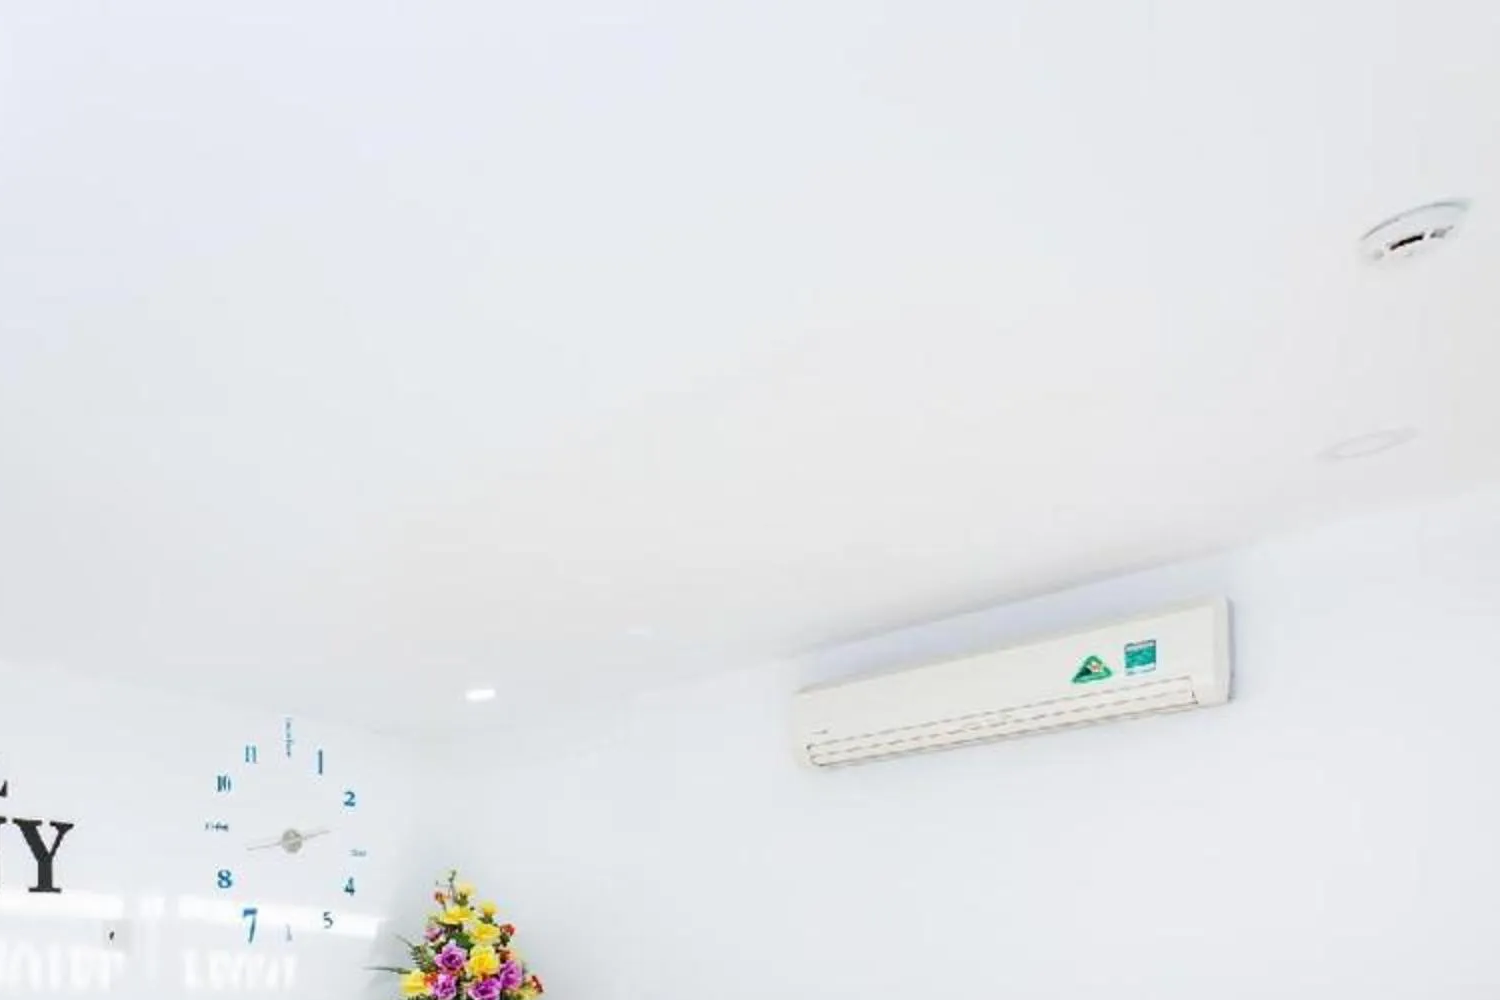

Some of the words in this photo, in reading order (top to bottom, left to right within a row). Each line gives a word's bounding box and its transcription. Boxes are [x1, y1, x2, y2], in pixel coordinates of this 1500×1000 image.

[343, 790, 357, 807] 2
[216, 869, 233, 889] 8
[343, 876, 356, 896] 4
[242, 907, 258, 943] 7
[322, 911, 334, 929] 5
